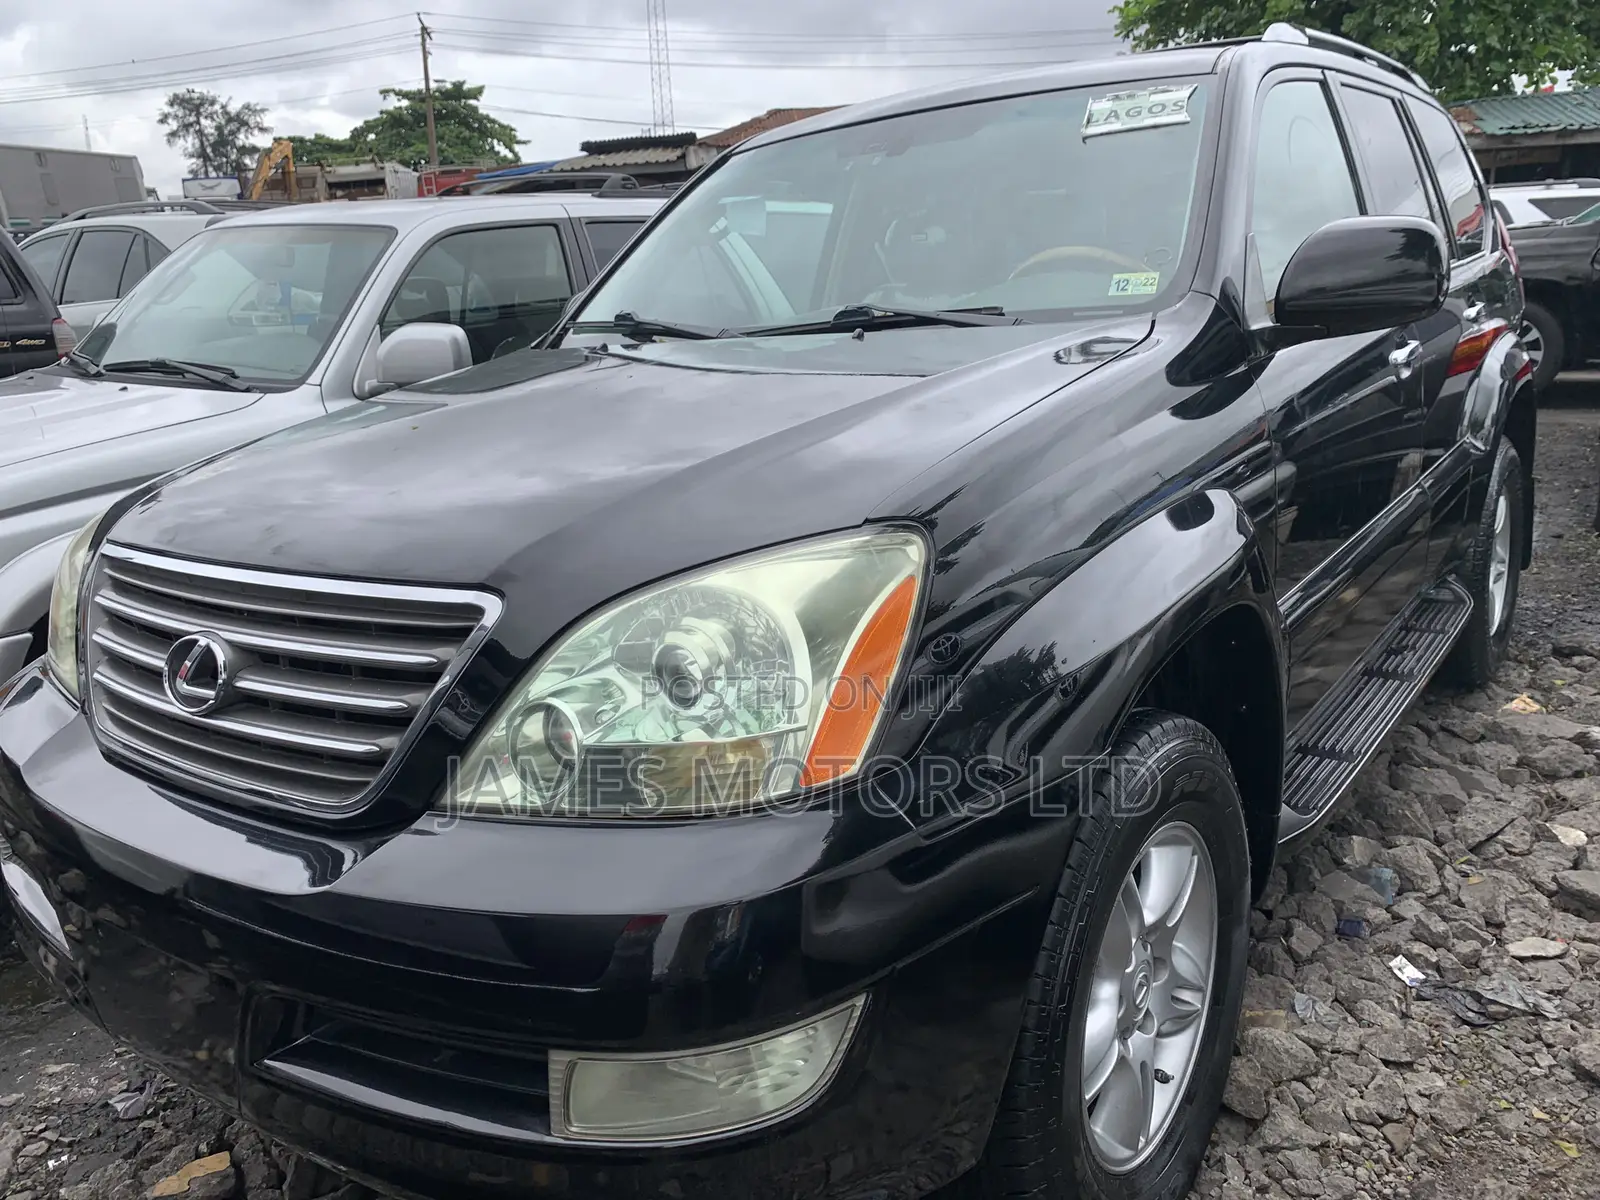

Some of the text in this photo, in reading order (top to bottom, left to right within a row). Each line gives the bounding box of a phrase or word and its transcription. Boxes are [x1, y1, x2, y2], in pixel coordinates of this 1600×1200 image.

[1088, 100, 1185, 123] LAGOS
[1114, 279, 1130, 292] 12
[1142, 277, 1157, 286] 22
